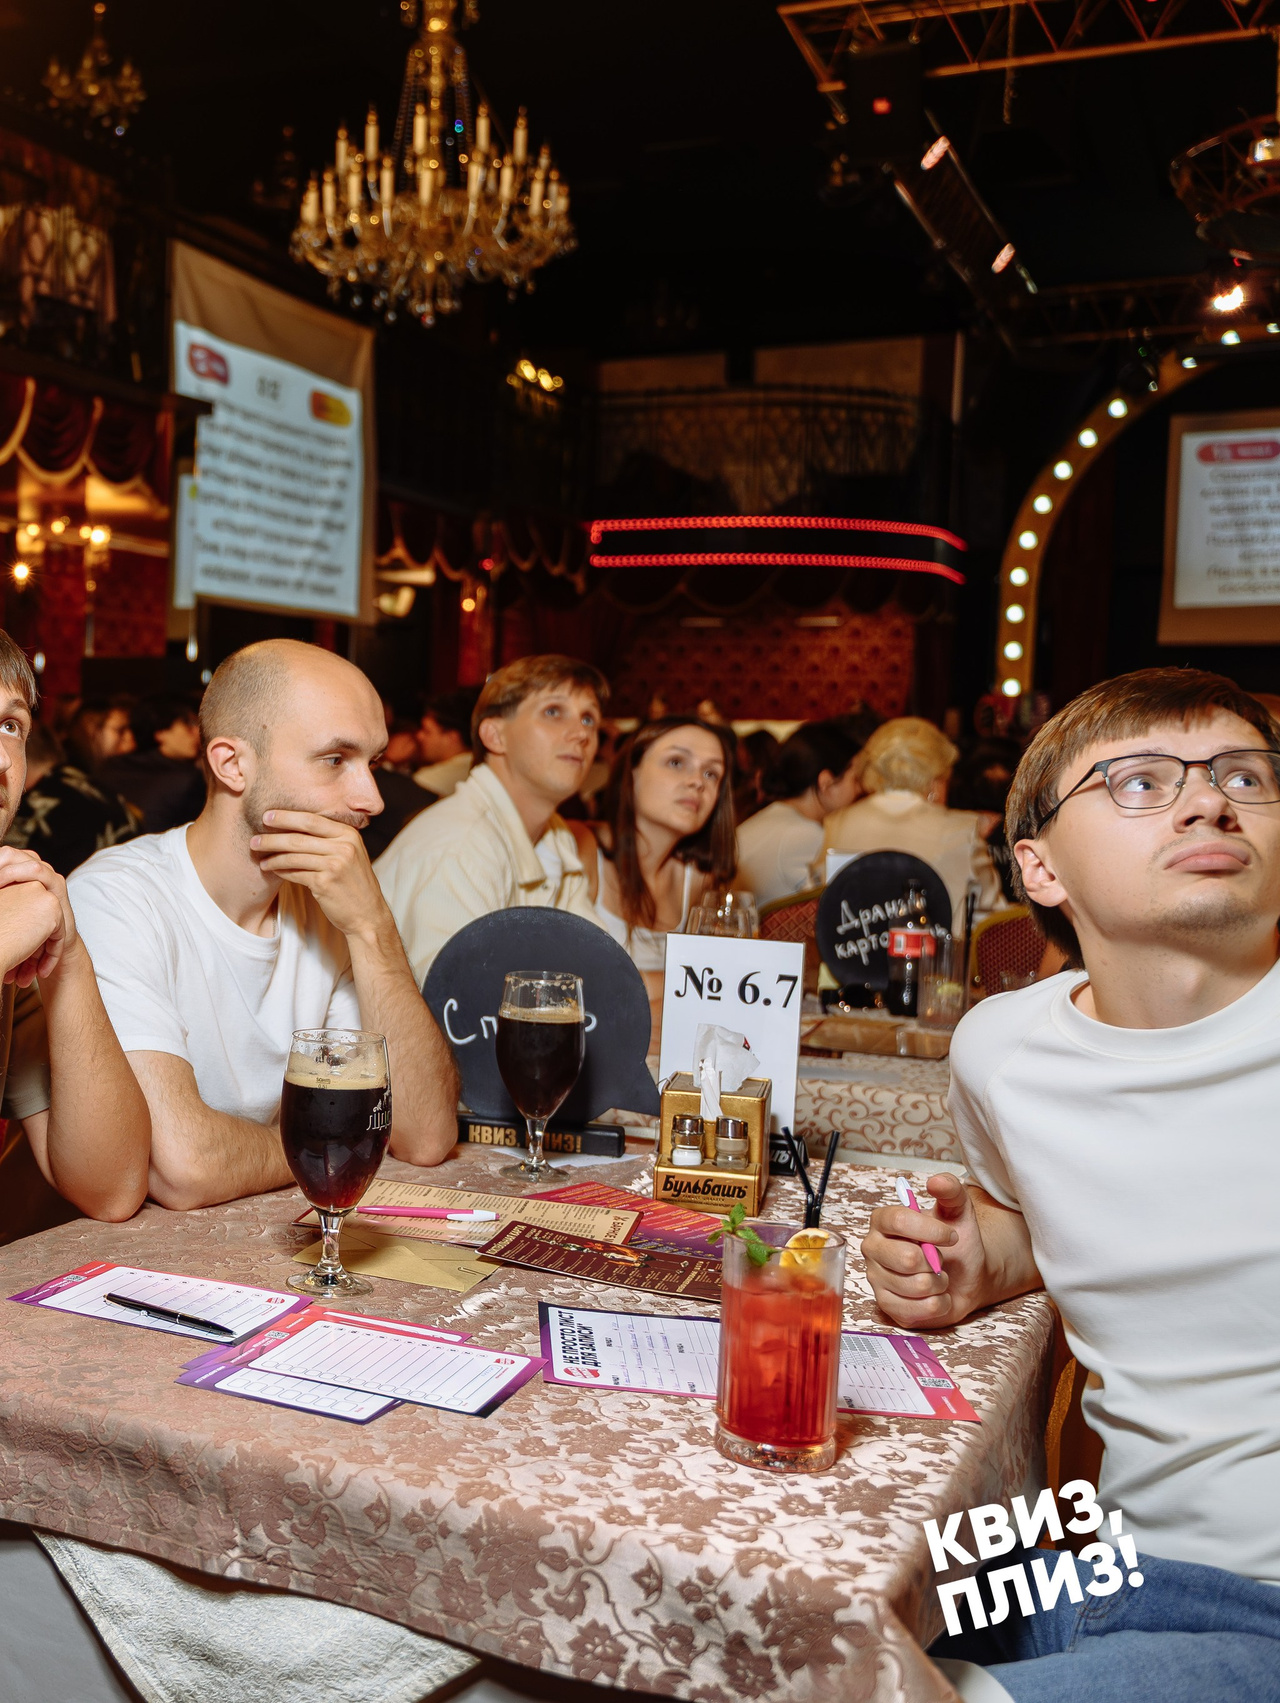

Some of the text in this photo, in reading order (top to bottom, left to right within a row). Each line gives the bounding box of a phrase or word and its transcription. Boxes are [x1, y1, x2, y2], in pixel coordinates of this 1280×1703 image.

[674, 965, 799, 1009] № 6.7
[468, 1124, 520, 1147] КВИЗ,
[558, 1310, 580, 1365] НЕ ПРОСТО ЛИСТ
[580, 1351, 601, 1367] ДЛЯ
